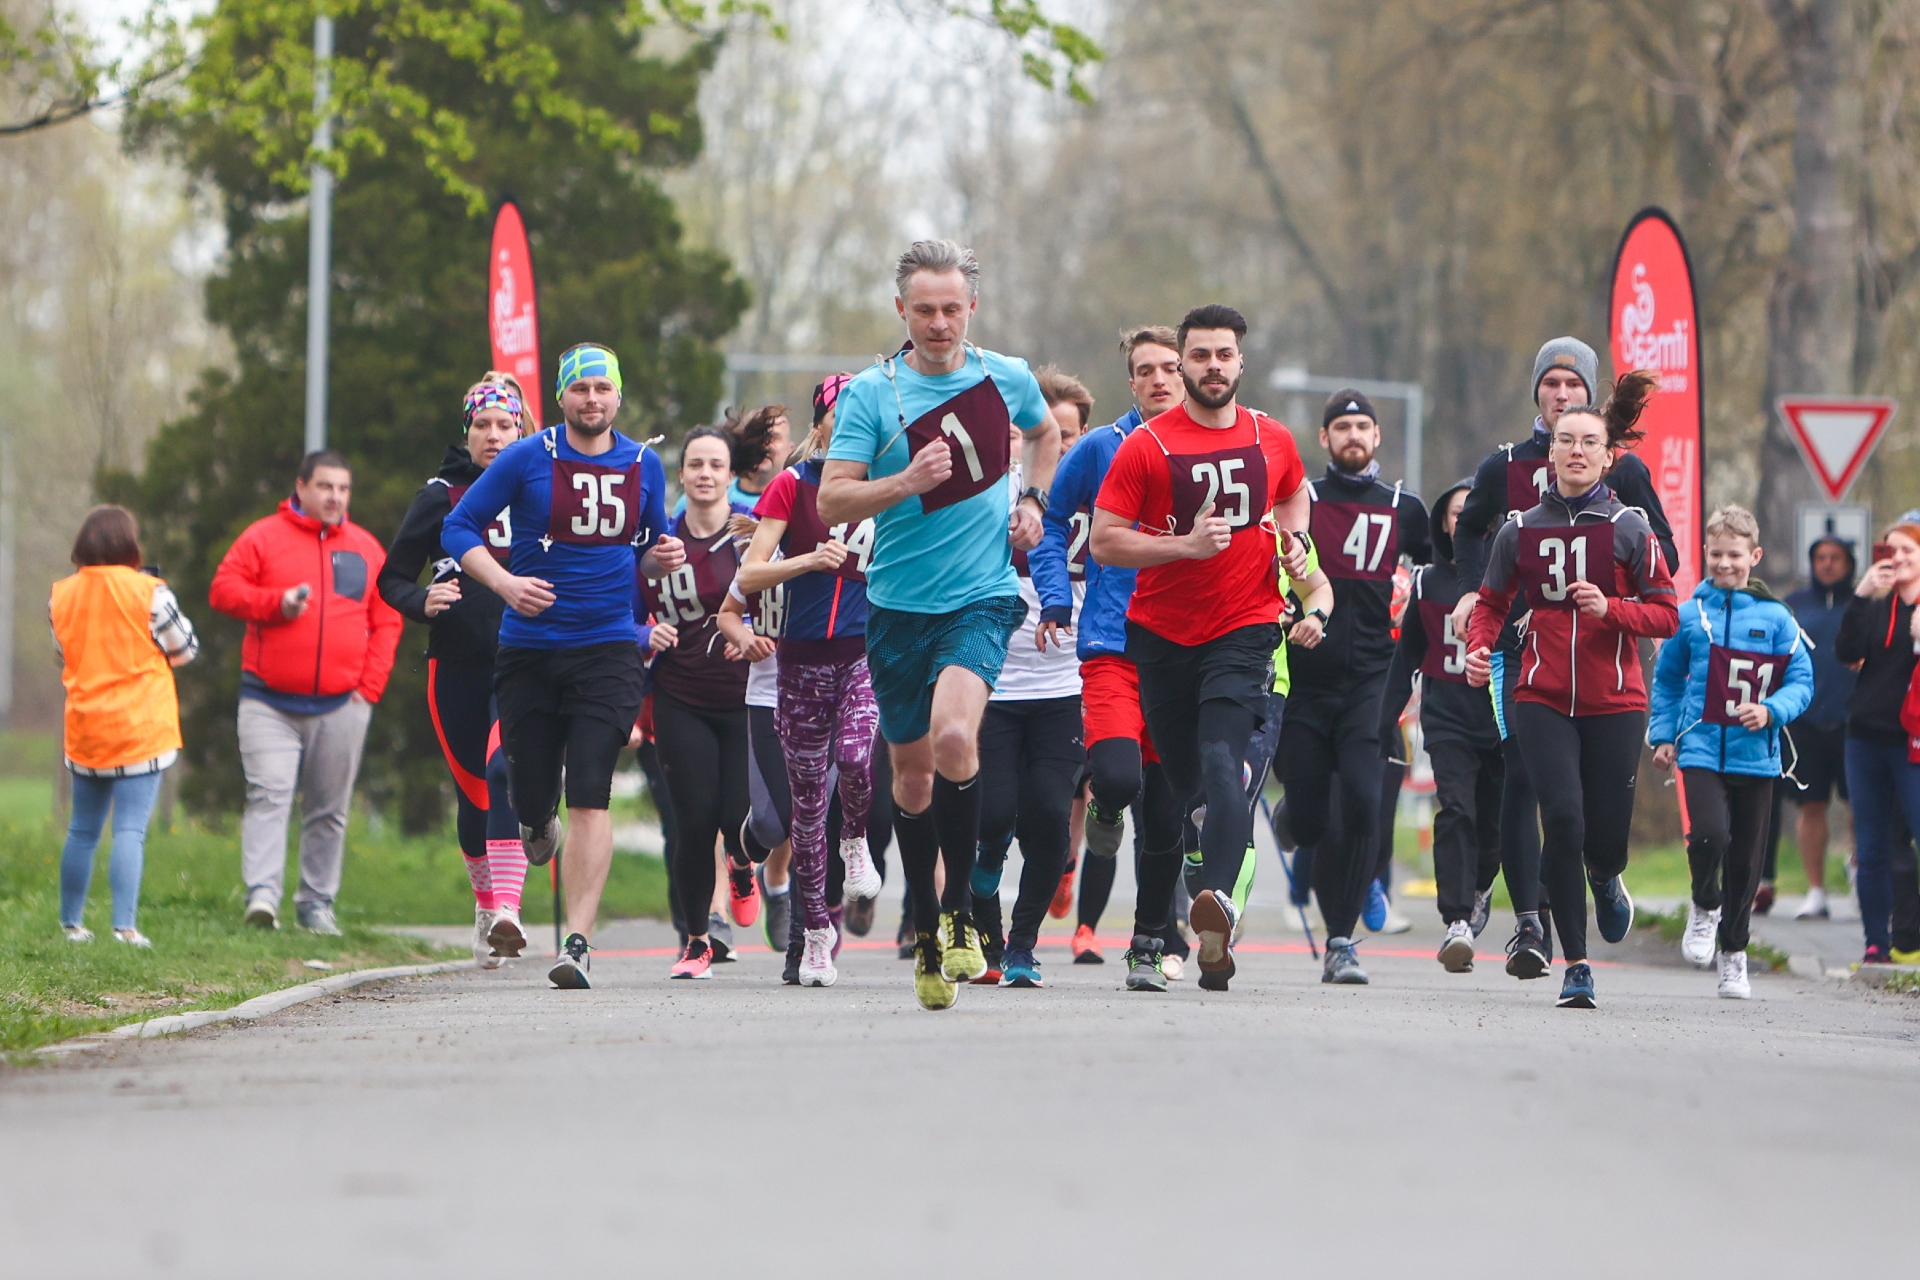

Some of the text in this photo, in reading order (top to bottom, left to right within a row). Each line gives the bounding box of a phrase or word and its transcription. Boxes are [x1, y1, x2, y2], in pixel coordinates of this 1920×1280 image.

[941, 412, 984, 482] 1
[571, 473, 626, 537] 35
[1192, 458, 1250, 527] 25
[1343, 512, 1392, 572] 47
[1539, 536, 1587, 601] 31
[648, 563, 705, 626] 39
[754, 583, 784, 638] 38
[1725, 658, 1774, 717] 51
